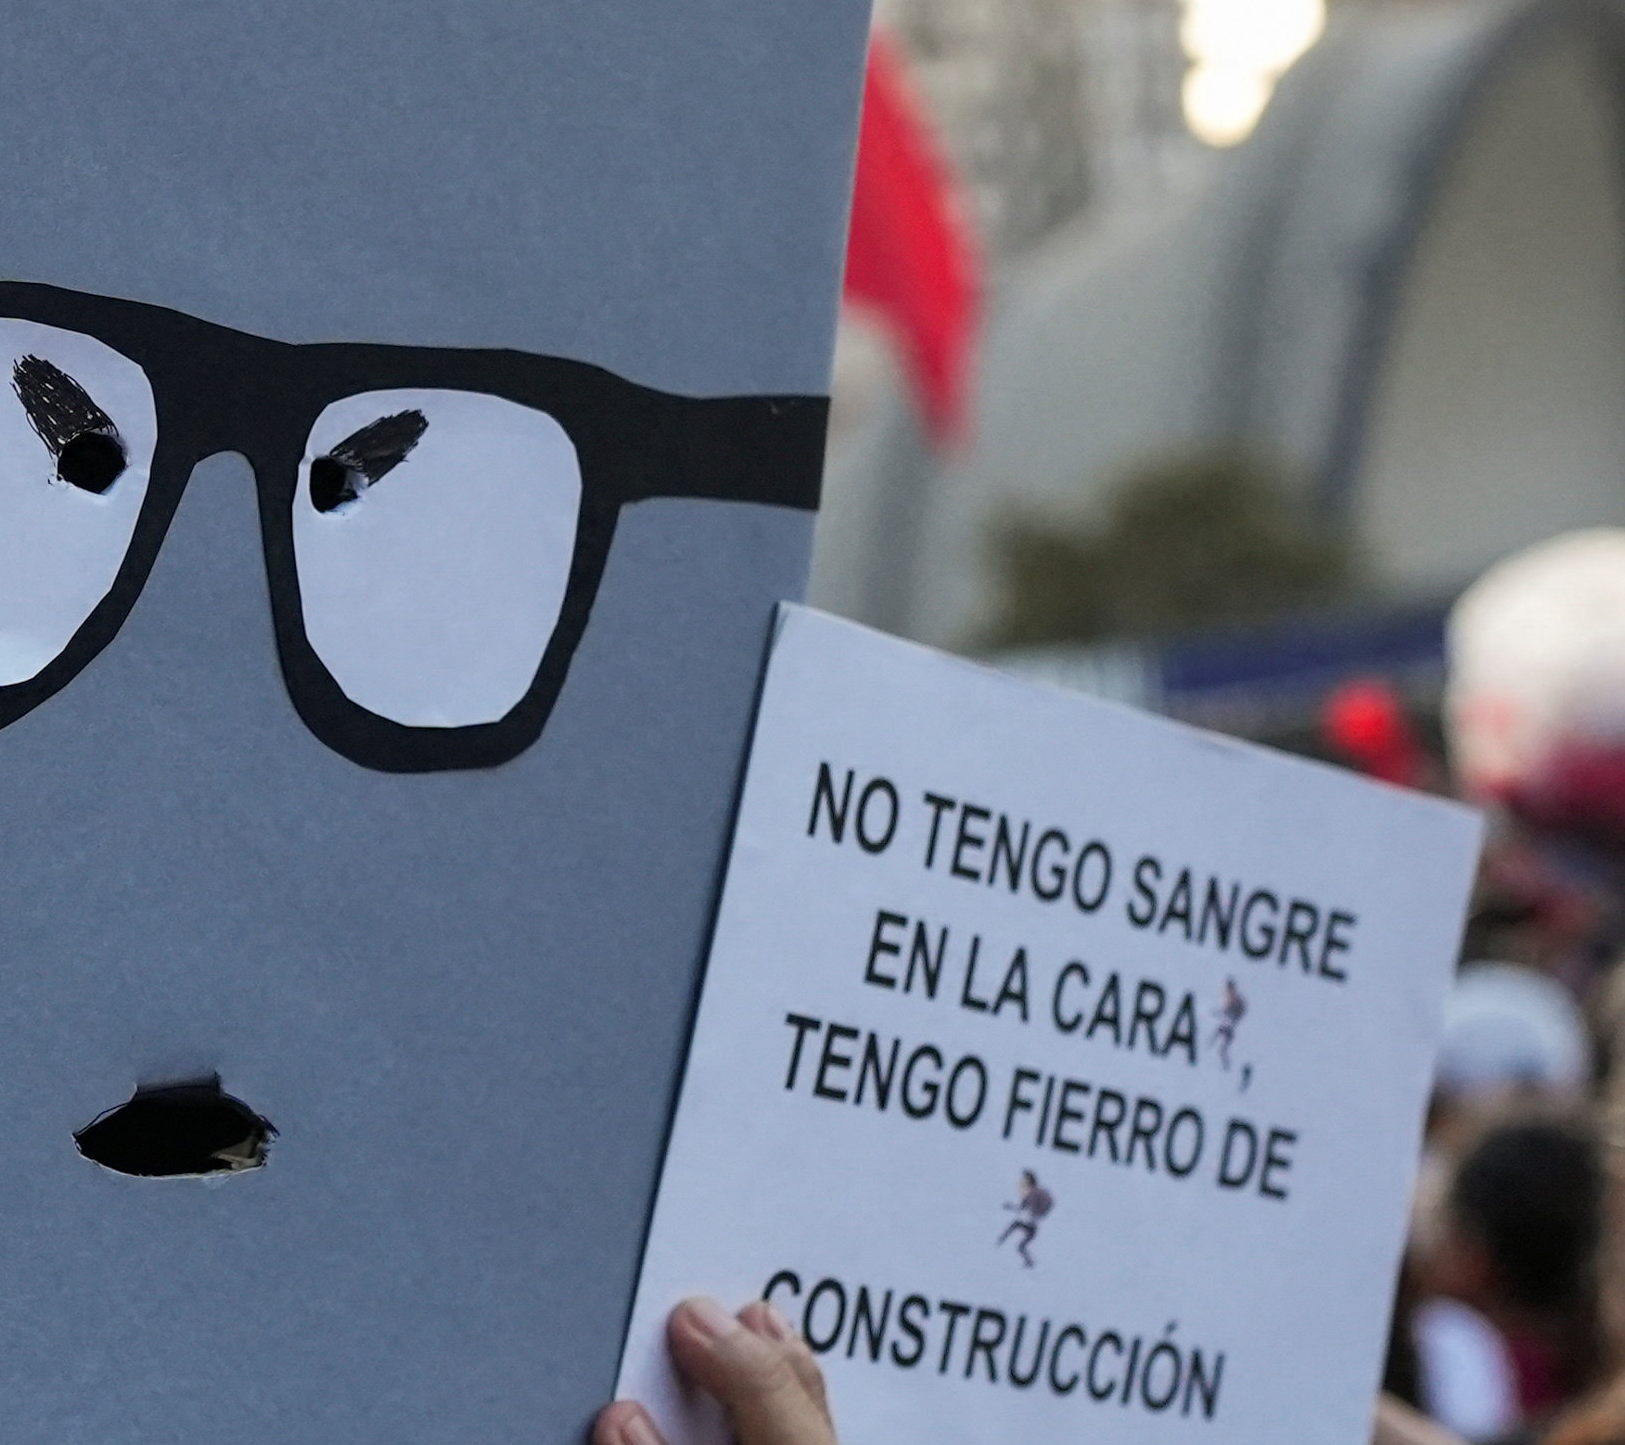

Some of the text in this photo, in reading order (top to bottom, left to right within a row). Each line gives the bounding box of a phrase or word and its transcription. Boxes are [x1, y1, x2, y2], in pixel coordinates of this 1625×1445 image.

[807, 762, 1357, 983] NO TENGO SANGRE
[864, 910, 947, 999] EN
[961, 936, 1030, 1022] LA
[783, 1013, 1298, 1199] TENGO FIERRO DE
